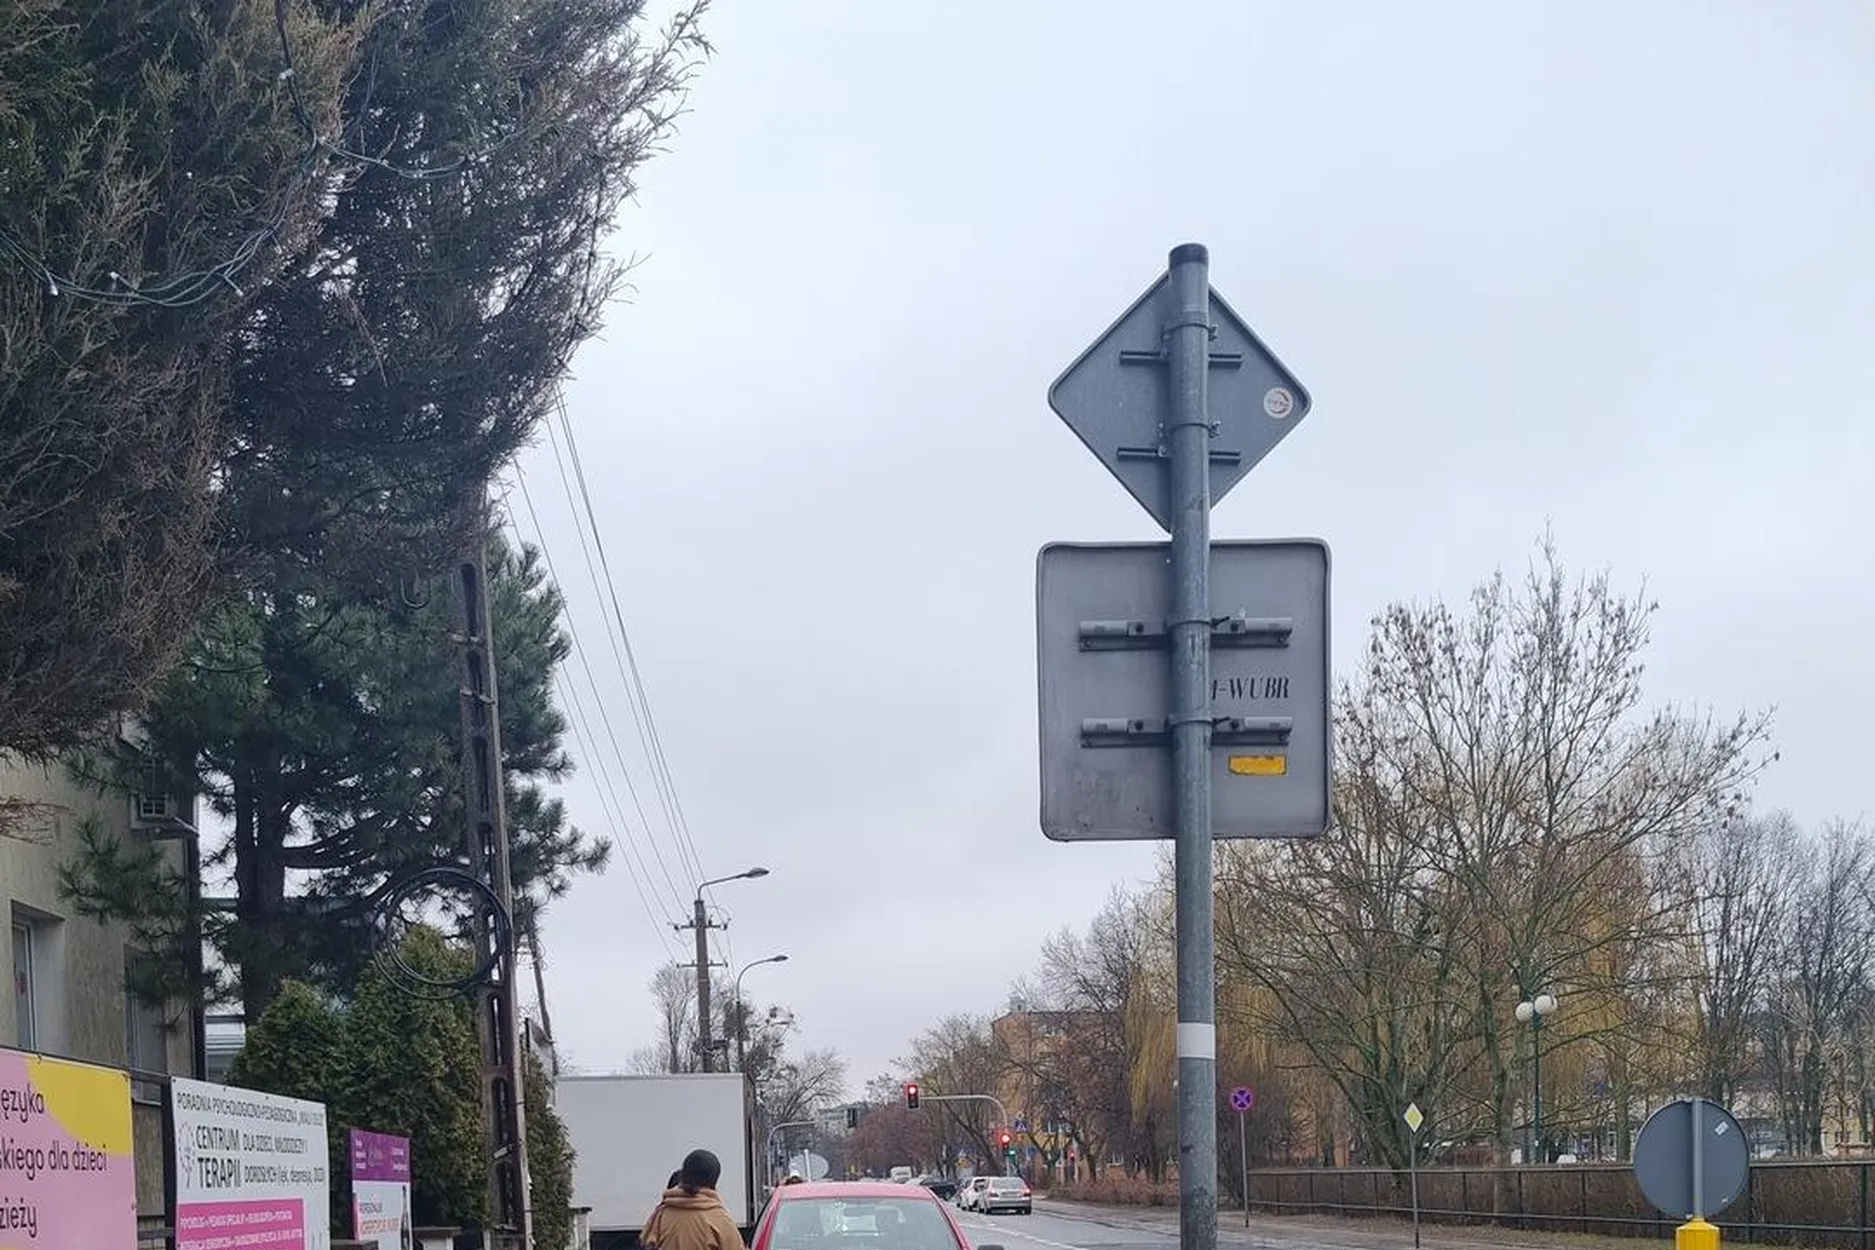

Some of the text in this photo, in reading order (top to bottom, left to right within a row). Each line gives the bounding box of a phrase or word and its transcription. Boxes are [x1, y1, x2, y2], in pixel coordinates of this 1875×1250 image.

[196, 1125, 240, 1151] CENTRUM
[0, 1136, 107, 1180] kiego dla dzieci
[197, 1157, 241, 1188] TERAPII
